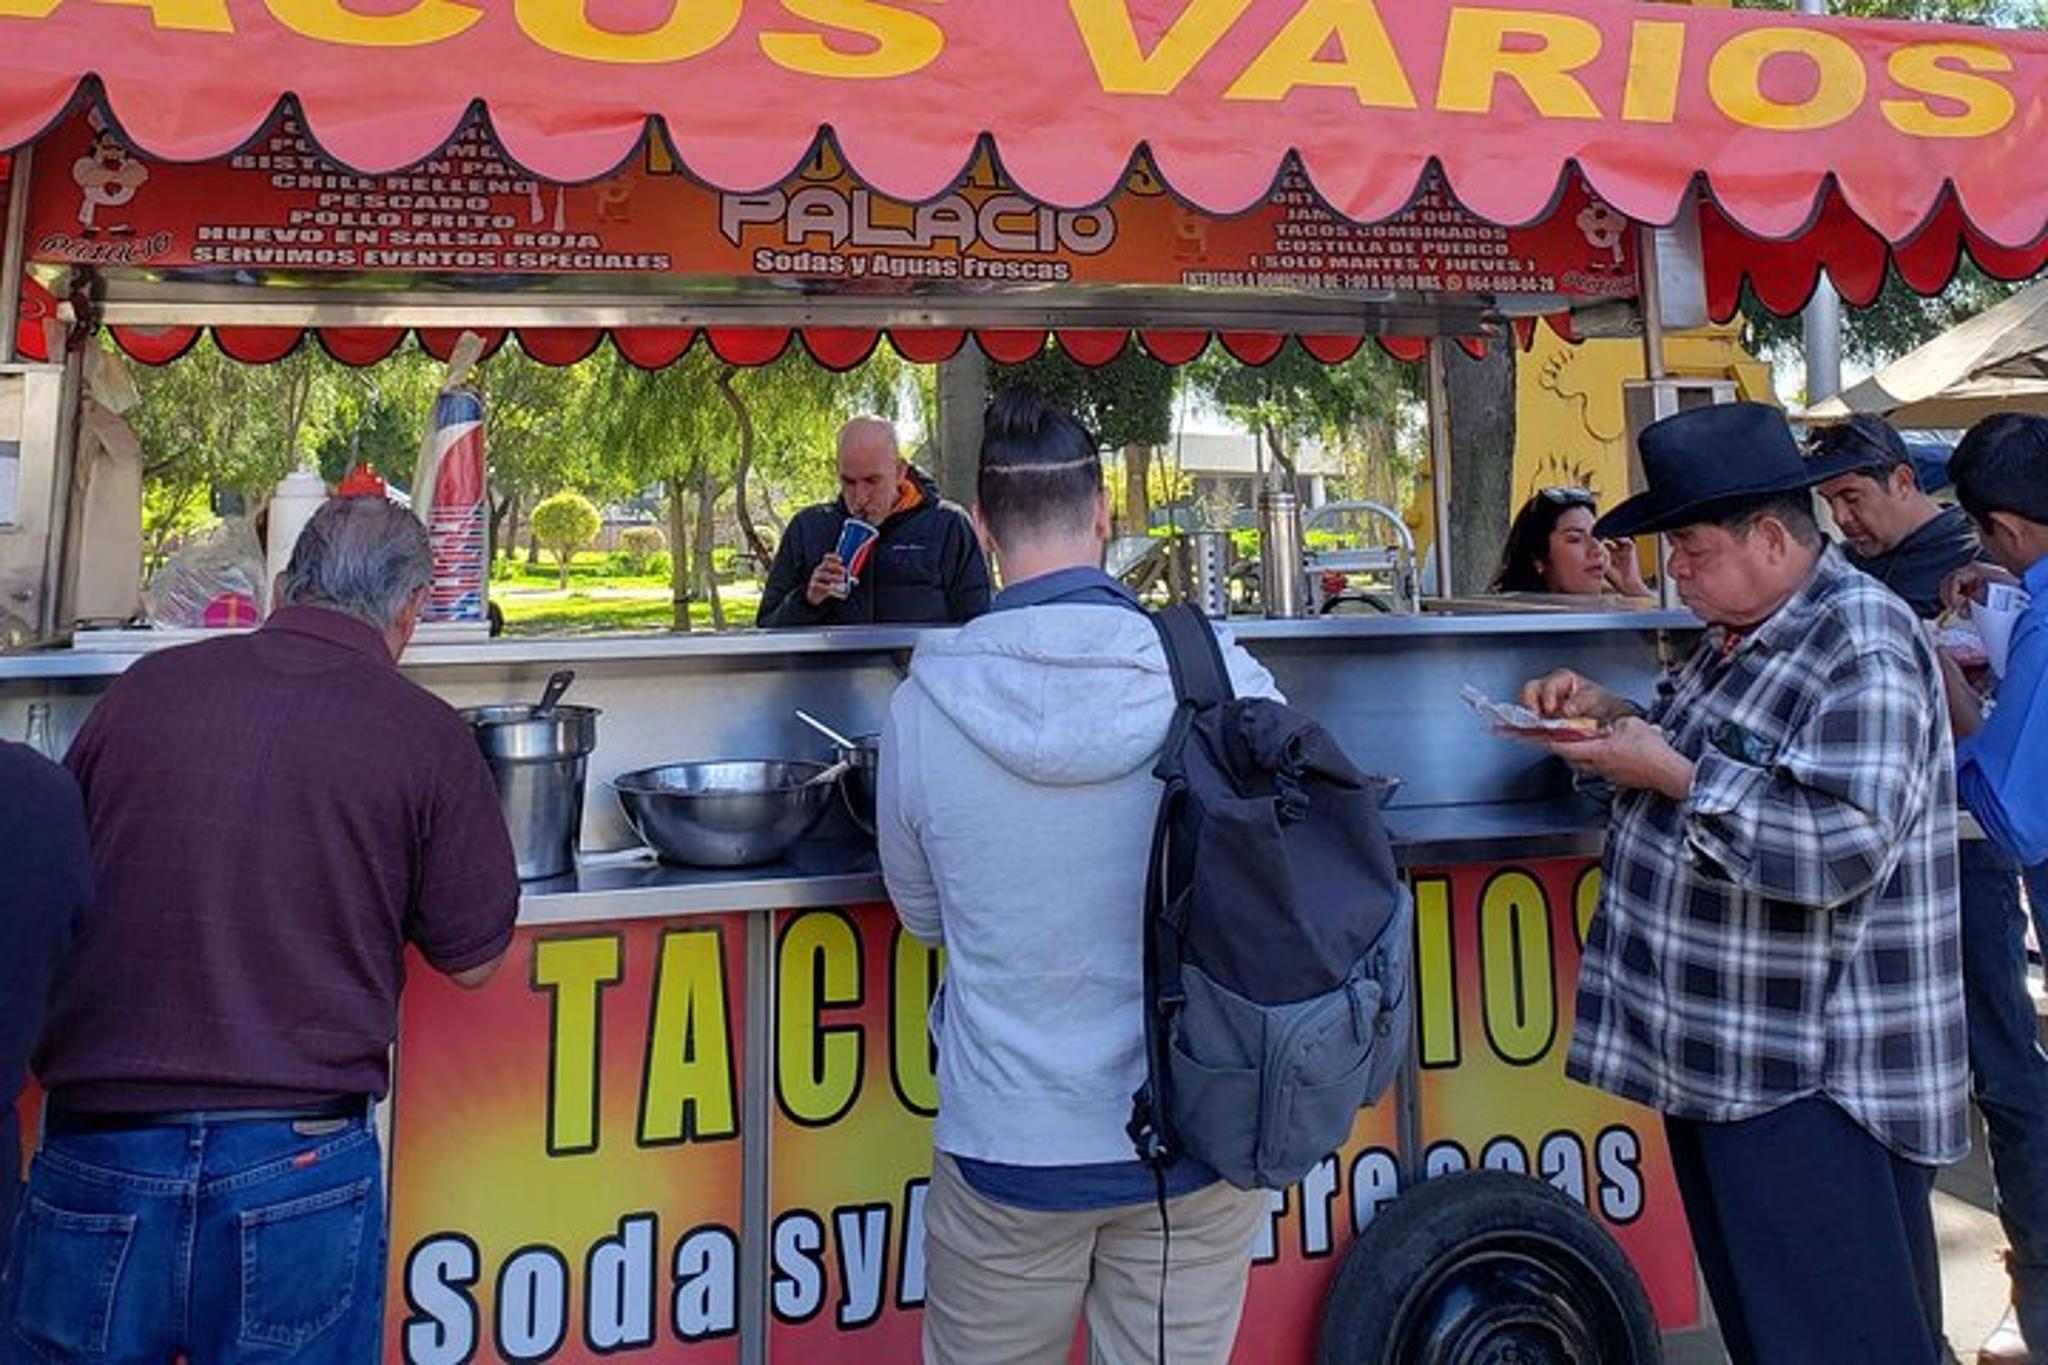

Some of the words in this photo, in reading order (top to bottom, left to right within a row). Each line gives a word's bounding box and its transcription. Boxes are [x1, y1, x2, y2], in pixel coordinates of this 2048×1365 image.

[1066, 0, 2018, 138] VARIOS
[386, 178, 536, 195] RELLENO
[319, 195, 490, 211] PESCADO
[290, 210, 402, 226] POLLO
[412, 214, 516, 229] FRITO
[718, 184, 1118, 256] PALACIO
[197, 226, 325, 243] HUEVO
[335, 230, 380, 244] EN
[389, 232, 503, 247] SALSA
[513, 235, 600, 249] ROJA
[1275, 224, 1350, 237] TACOS
[1275, 240, 1384, 254] COSTILLA
[1389, 241, 1416, 255] DE
[1421, 243, 1510, 256] PUERCO
[192, 247, 357, 265] SERVIMOS
[363, 250, 497, 268] EVENTOS
[503, 252, 671, 270] ESPECIALES
[754, 250, 845, 274] Sodas
[850, 254, 867, 277] y
[871, 253, 959, 279] Aguas
[962, 256, 1071, 282] Frescas
[1329, 256, 1419, 270] MARTES
[1426, 258, 1439, 271] Y
